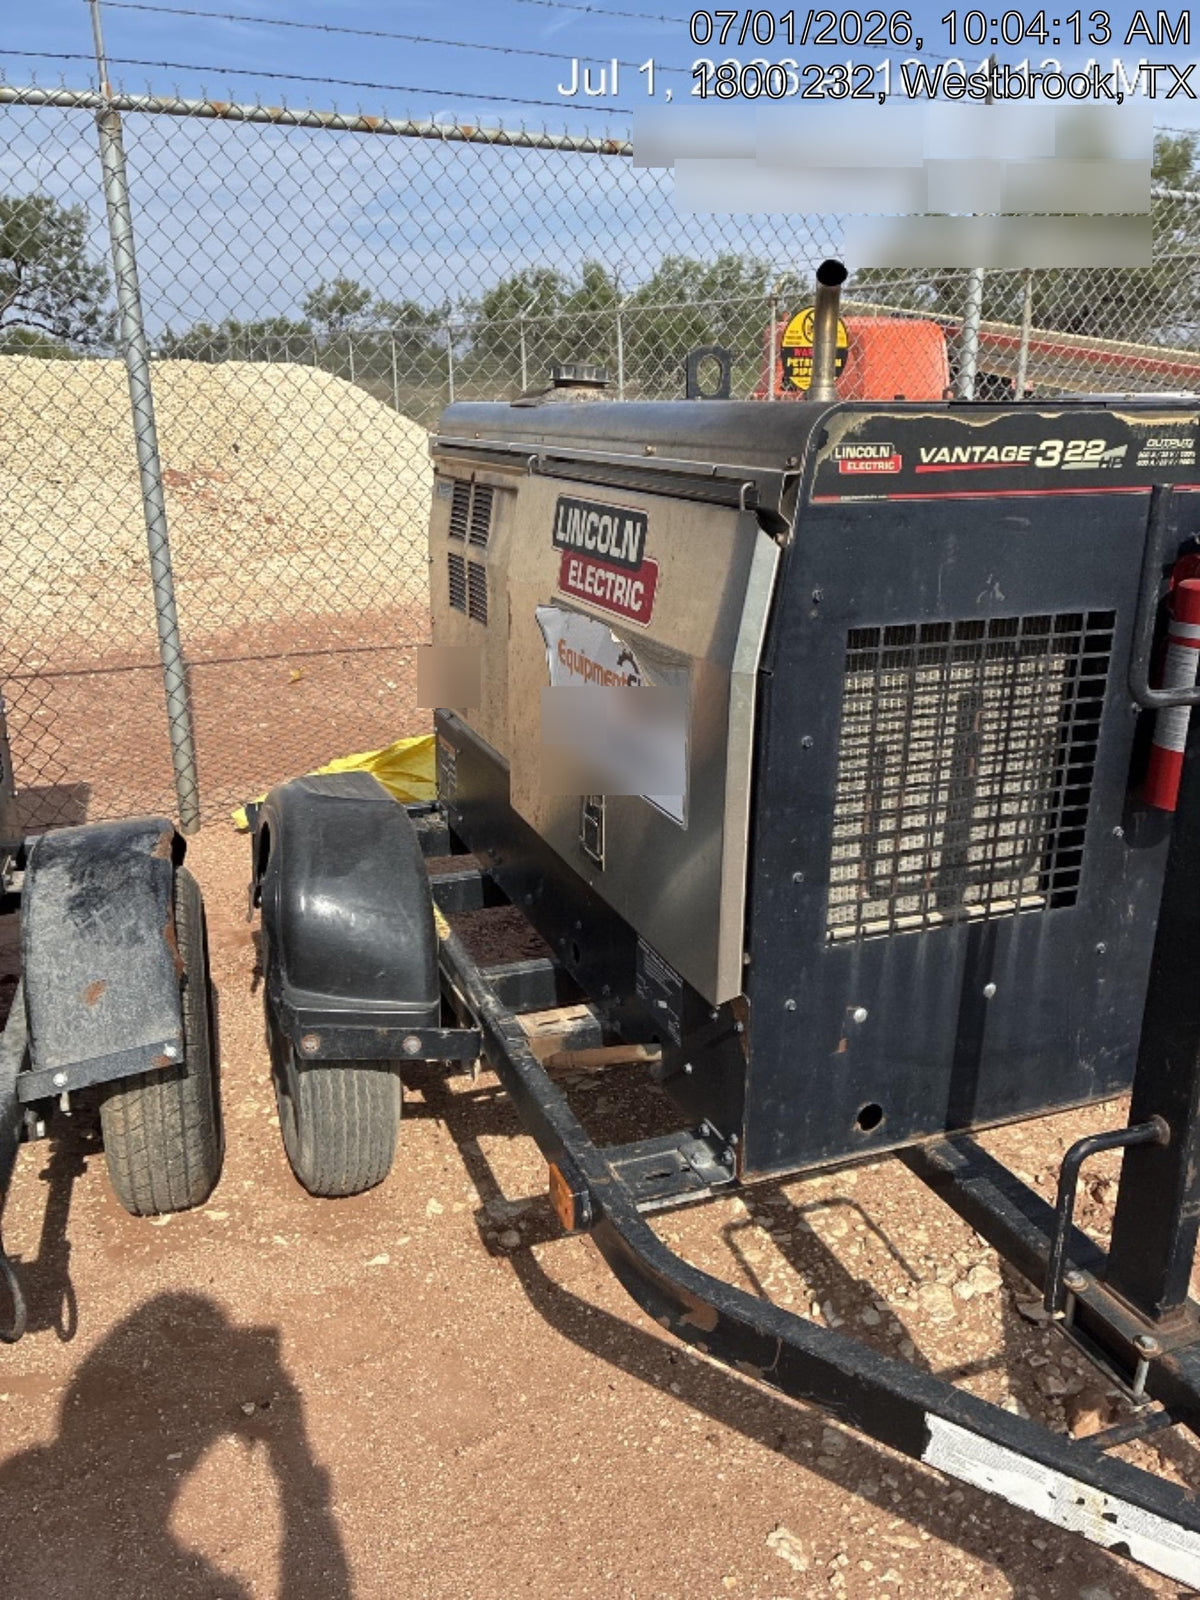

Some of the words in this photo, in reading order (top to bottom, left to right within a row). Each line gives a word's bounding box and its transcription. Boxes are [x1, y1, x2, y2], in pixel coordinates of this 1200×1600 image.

[834, 446, 890, 459] LINCOLN
[847, 460, 896, 471] ELECTRIC
[919, 445, 1034, 464] VANTAGE
[1034, 438, 1107, 468] 322
[556, 505, 641, 562] LINCOLN
[568, 560, 645, 611] ELECTRIC
